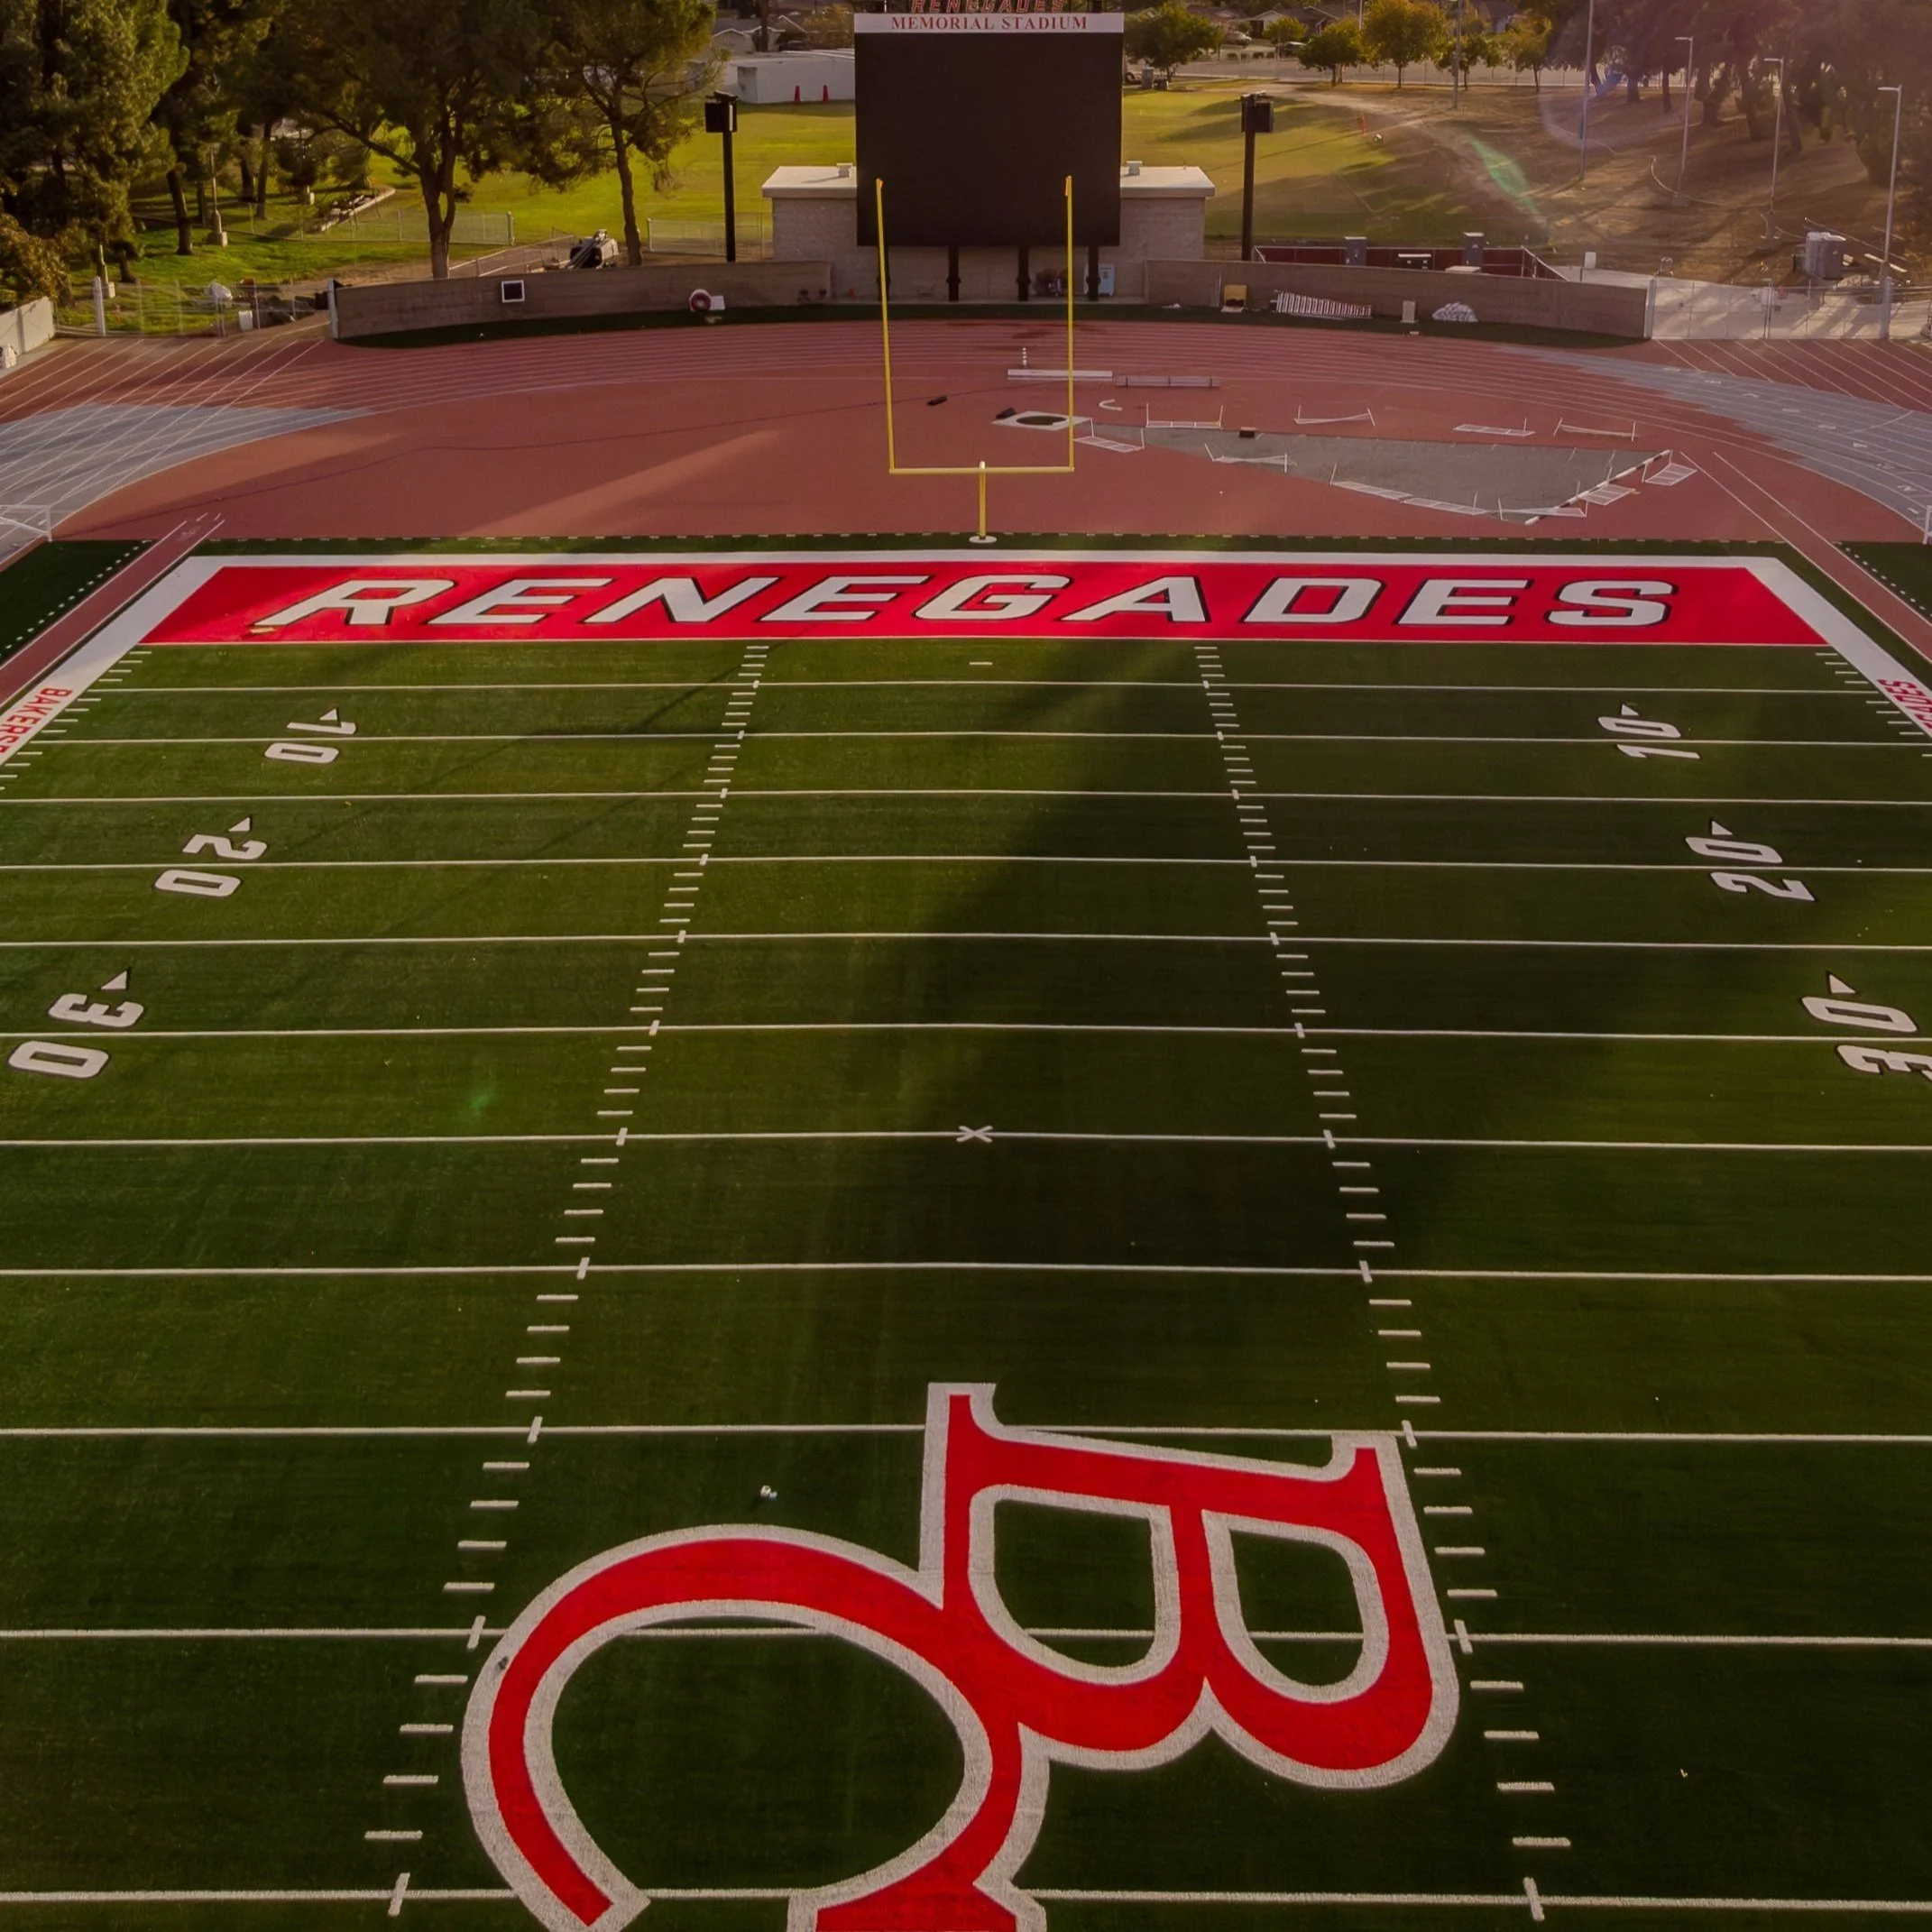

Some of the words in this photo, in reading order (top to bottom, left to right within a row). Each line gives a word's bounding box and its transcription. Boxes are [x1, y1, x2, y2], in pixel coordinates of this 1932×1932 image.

[891, 16, 994, 30] MEMORIAL
[1001, 16, 1087, 30] STADIUM
[252, 577, 1678, 627] RENEGADES
[264, 721, 357, 764] 10
[1597, 716, 1701, 759] 10
[154, 833, 268, 897] 20
[1684, 836, 1816, 902] 20
[8, 993, 145, 1079] 30
